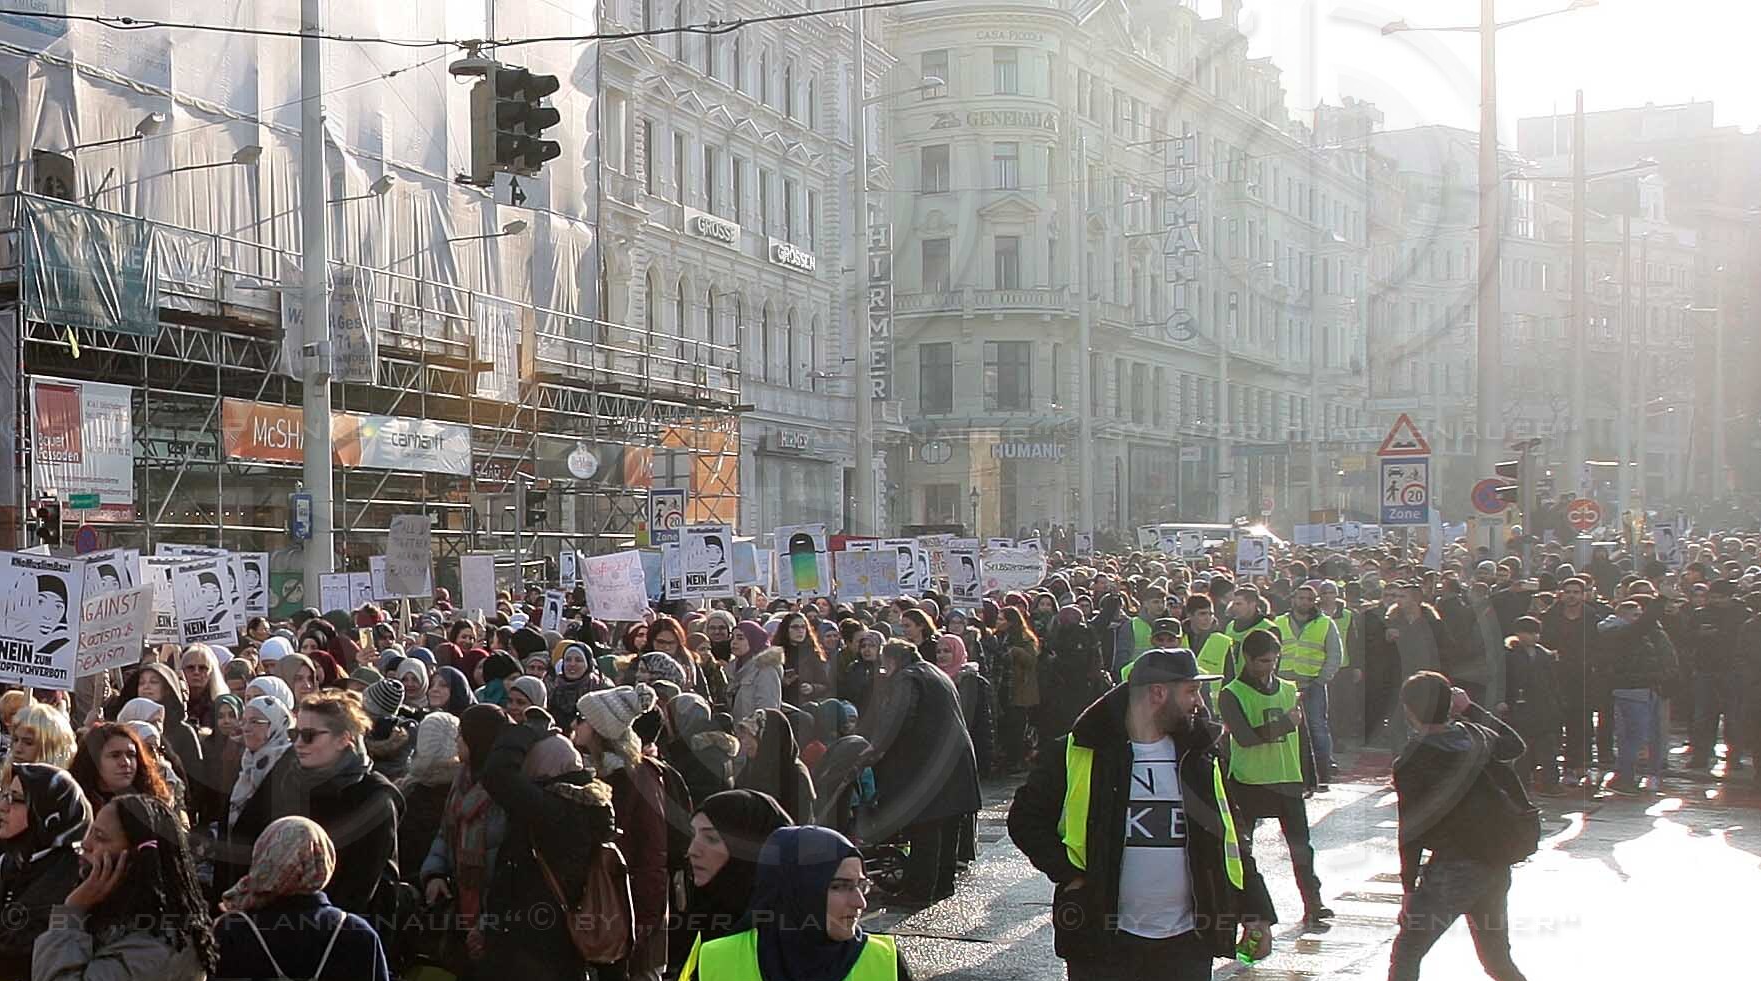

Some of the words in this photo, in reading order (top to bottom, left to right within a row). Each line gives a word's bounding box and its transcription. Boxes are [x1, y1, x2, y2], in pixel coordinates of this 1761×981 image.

[1390, 508, 1421, 520] Zone
[686, 573, 707, 586] NEIN
[183, 620, 207, 635] NEIN
[34, 655, 52, 666] ZUM
